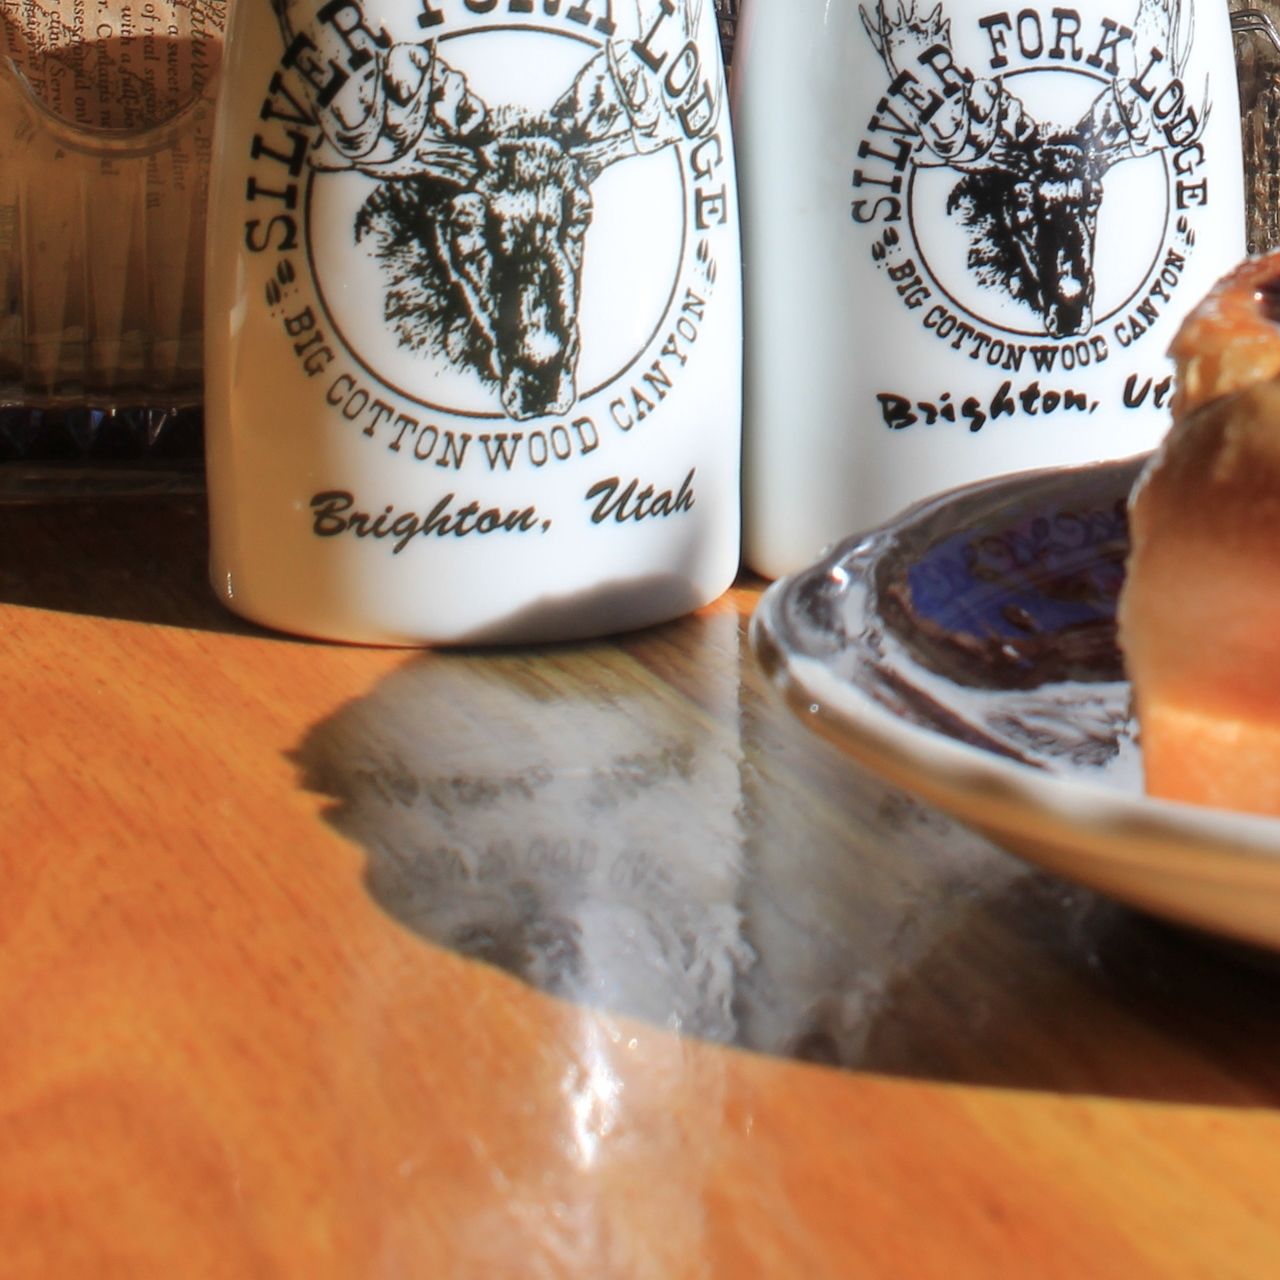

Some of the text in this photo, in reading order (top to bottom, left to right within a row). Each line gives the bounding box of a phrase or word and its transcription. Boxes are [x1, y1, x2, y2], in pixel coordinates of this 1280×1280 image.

[121, 8, 136, 46] with
[140, 3, 161, 22] of
[121, 53, 130, 64] a
[144, 27, 160, 61] real
[167, 42, 180, 92] sweet
[74, 97, 93, 125] onl
[852, 8, 1208, 225] SILVER FORK LODGE
[888, 258, 930, 310] BIG
[1113, 248, 1186, 347] CANYON
[284, 306, 337, 378] BIG
[608, 288, 708, 432] CANYON
[876, 374, 1173, 433] Brighton, Ut
[309, 467, 697, 555] Brighton, Utah
